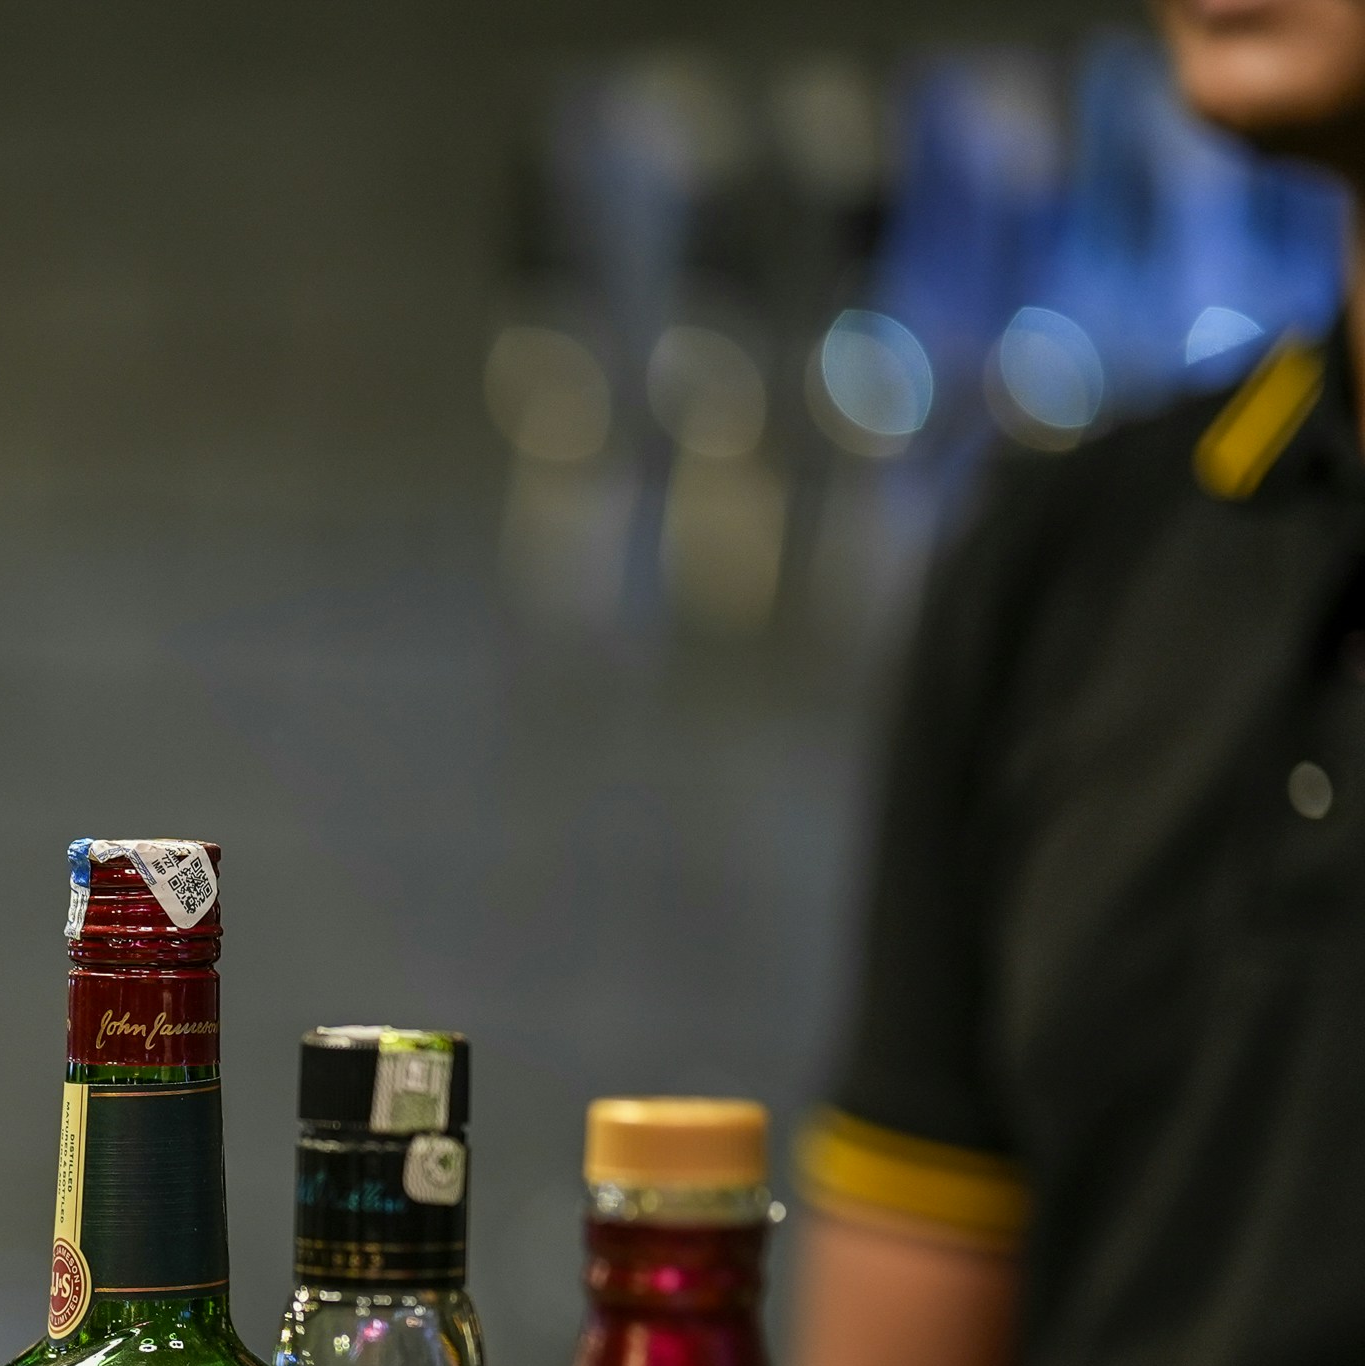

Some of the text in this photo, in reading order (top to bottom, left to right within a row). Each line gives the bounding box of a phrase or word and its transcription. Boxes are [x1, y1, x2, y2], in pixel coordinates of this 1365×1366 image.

[151, 859, 166, 875] IMP
[162, 854, 174, 868] 727
[95, 1009, 146, 1050] John
[67, 1133, 75, 1193] DISTILLED
[56, 1246, 81, 1283] JAMESON
[54, 1295, 79, 1326] LIMITED
